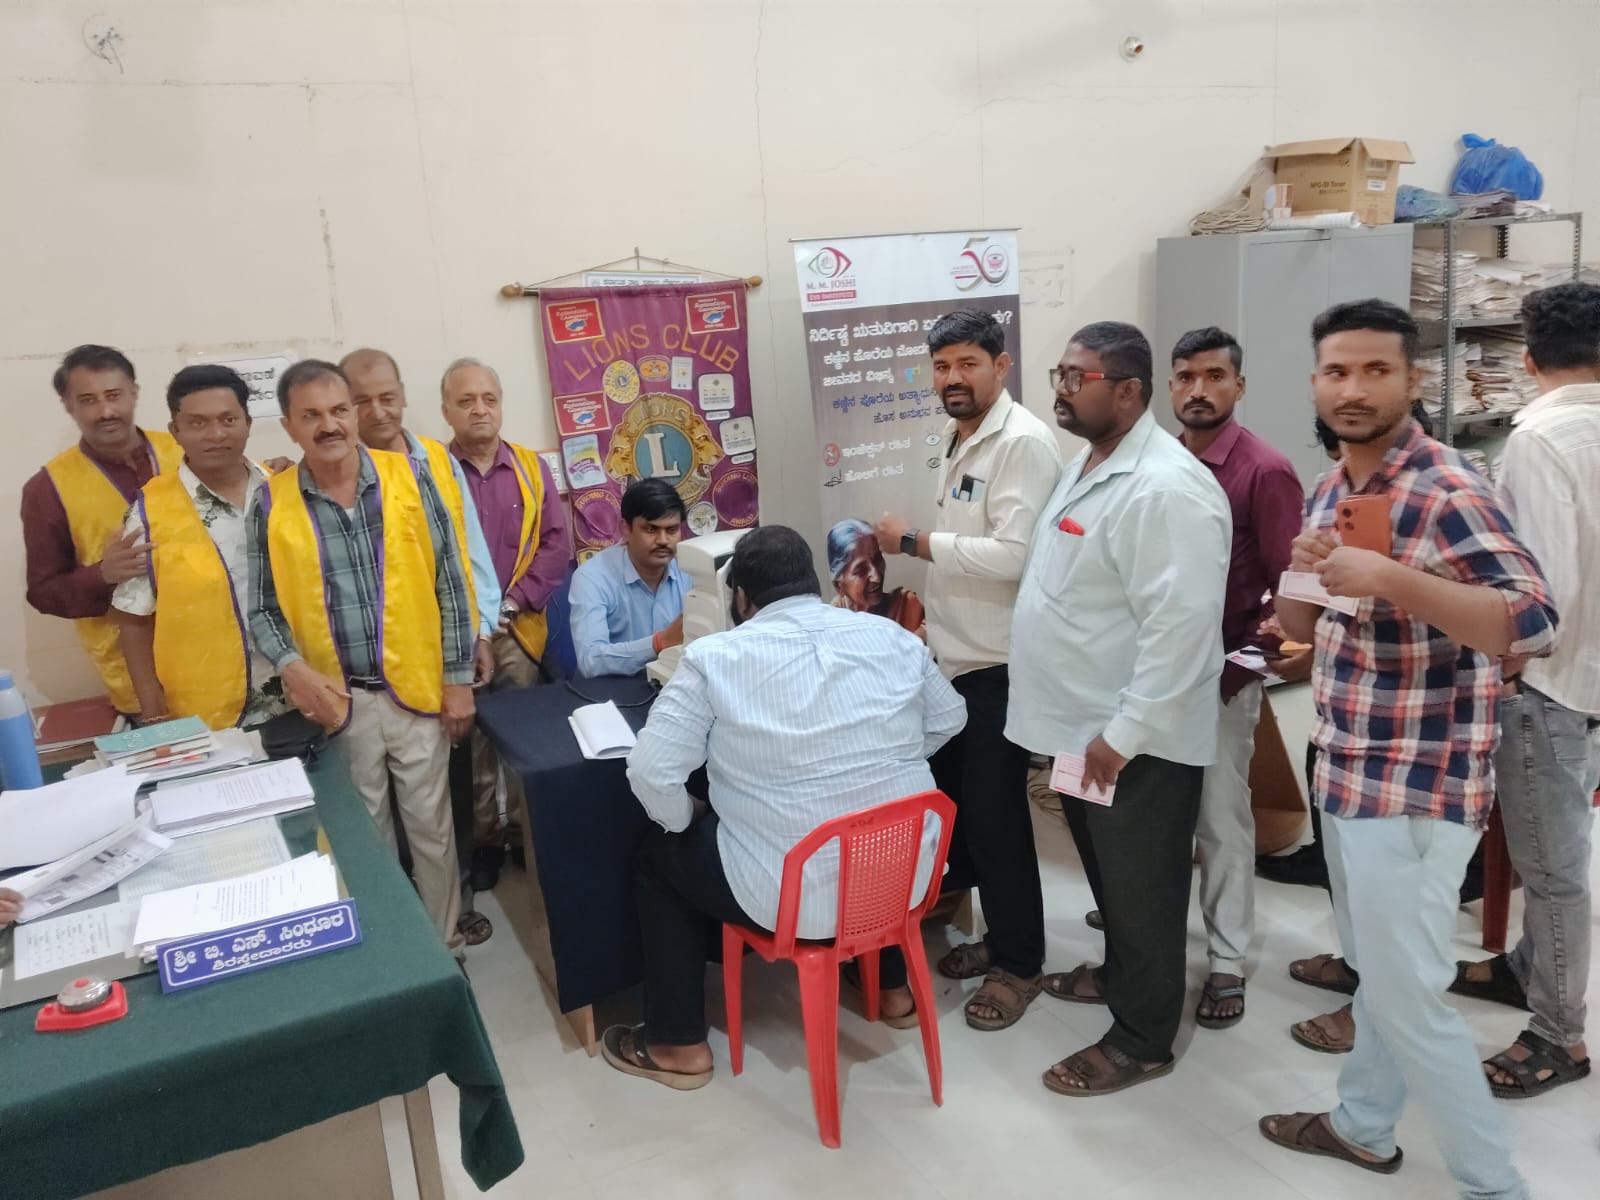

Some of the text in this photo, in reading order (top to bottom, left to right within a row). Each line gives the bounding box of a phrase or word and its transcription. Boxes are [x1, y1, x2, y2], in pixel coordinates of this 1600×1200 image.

[831, 279, 857, 289] JOSHI
[563, 323, 740, 381] LIONS CLUB
[632, 402, 688, 425] LIONS
[643, 432, 680, 477] L
[173, 950, 197, 973] ಶ್ರೀ
[279, 910, 345, 941] ಸಿಂಧೂರ
